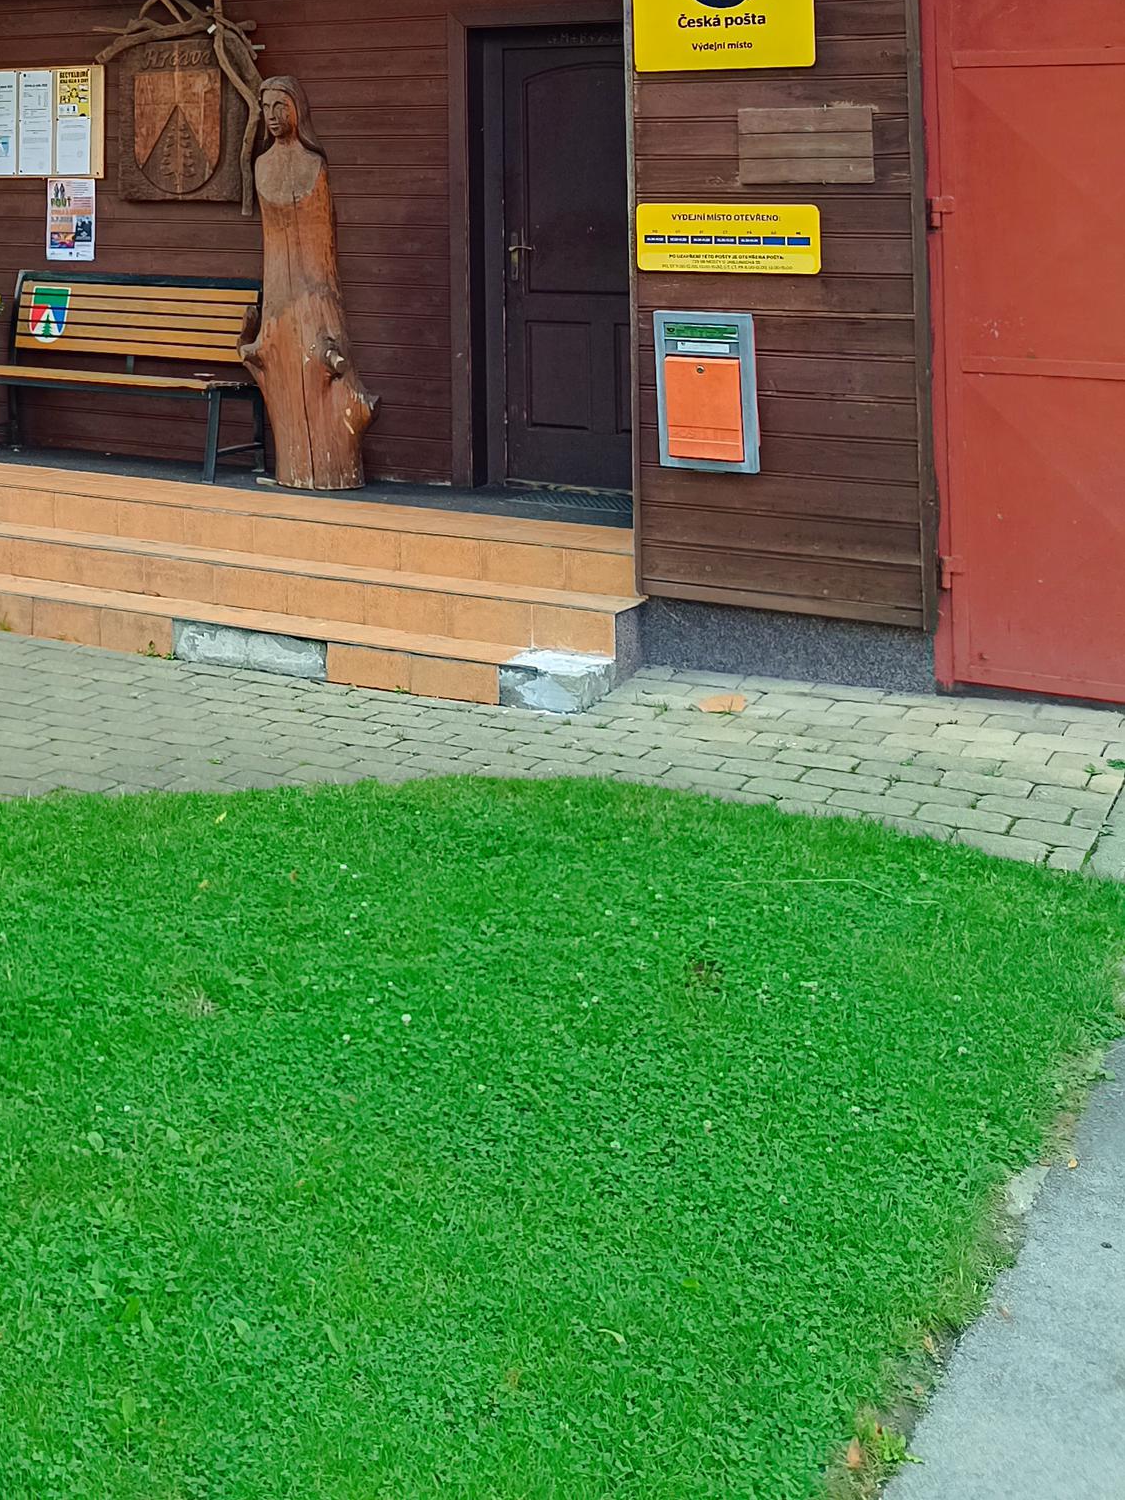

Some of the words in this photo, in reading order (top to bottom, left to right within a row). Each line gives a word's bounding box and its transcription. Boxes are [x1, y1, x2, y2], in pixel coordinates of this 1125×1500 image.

[677, 13, 721, 29] Česká
[724, 12, 767, 29] pošta
[691, 41, 726, 52] Výdejní
[727, 41, 753, 50] místo
[671, 212, 705, 221] VÝDEJNÍ
[706, 212, 732, 222] MÍSTO
